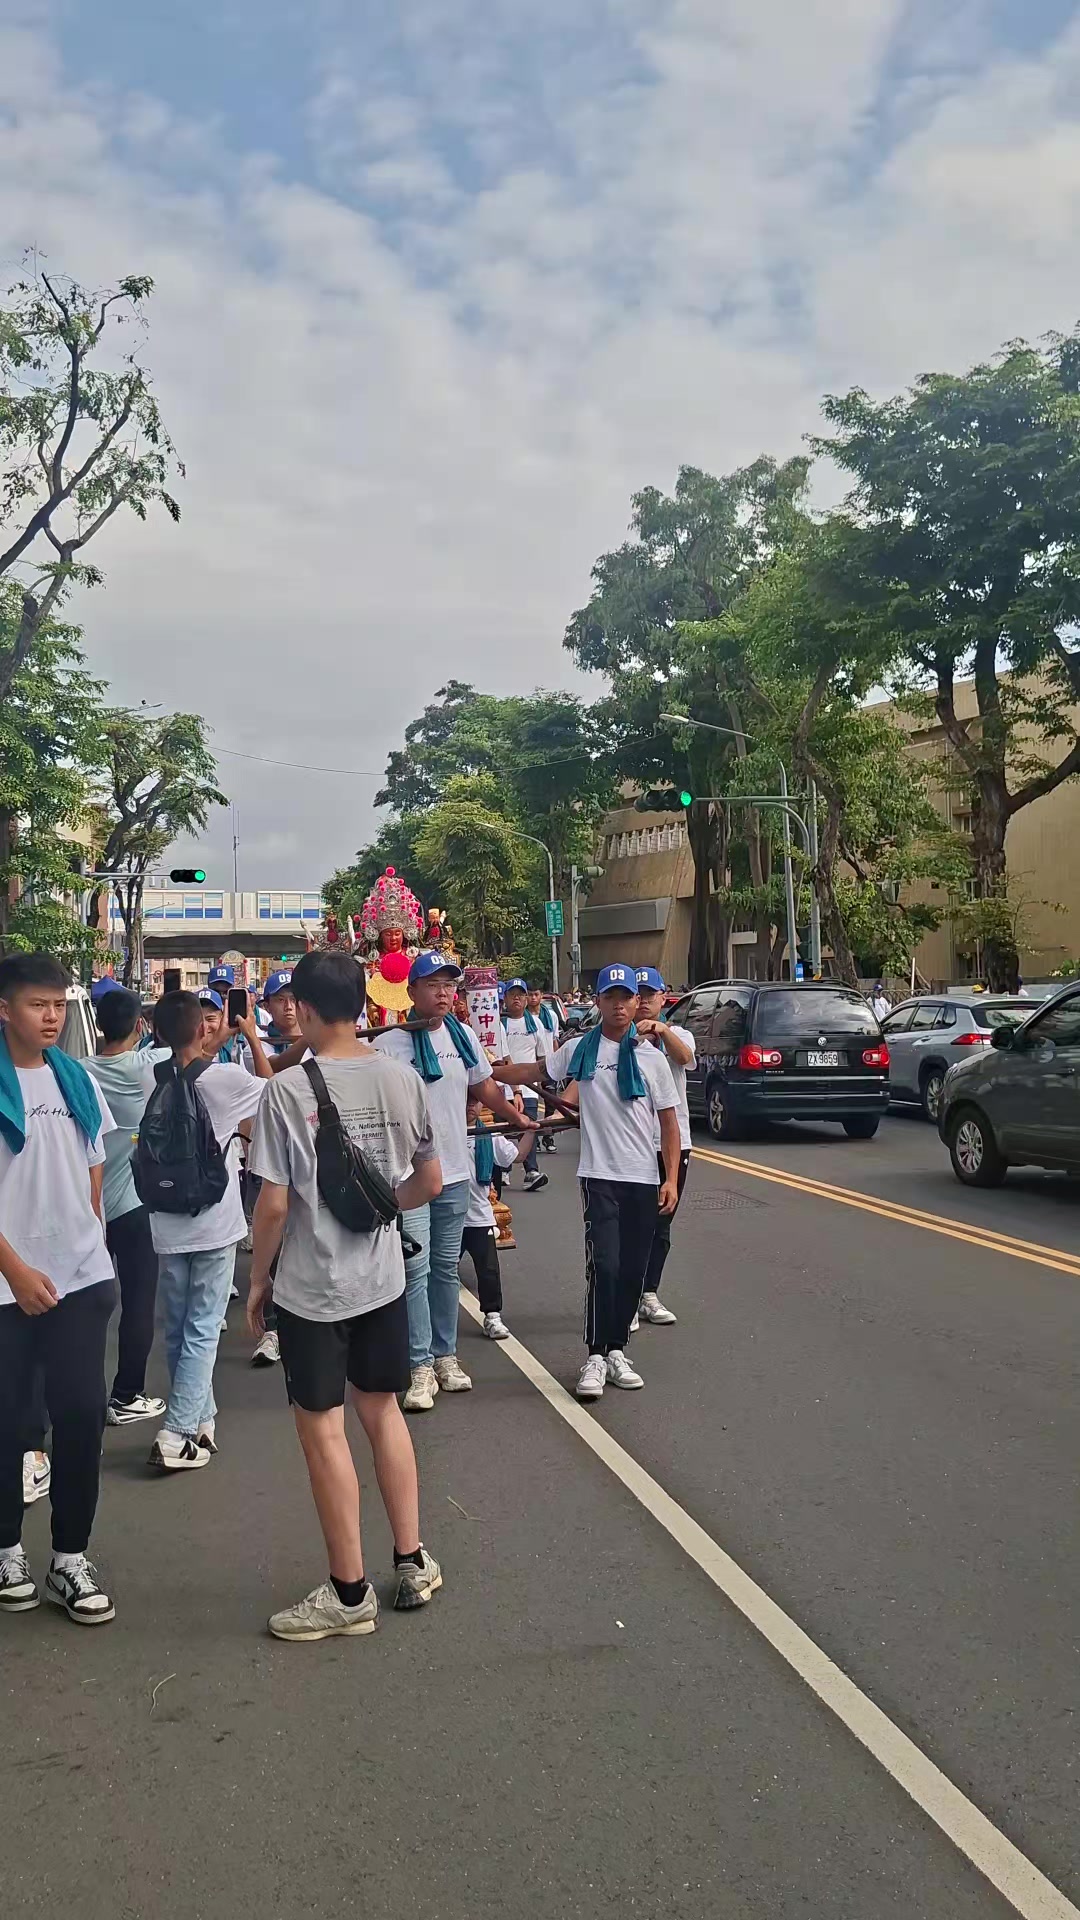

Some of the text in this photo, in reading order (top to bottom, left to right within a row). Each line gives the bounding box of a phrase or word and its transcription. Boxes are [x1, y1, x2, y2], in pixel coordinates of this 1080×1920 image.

[431, 955, 445, 965] 03
[279, 974, 291, 983] 03
[610, 970, 625, 980] 03
[636, 972, 648, 981] 03
[199, 991, 211, 999] 03
[478, 1013, 497, 1048] 中壇
[29, 1104, 49, 1117] XIN
[359, 1121, 386, 1130] National
